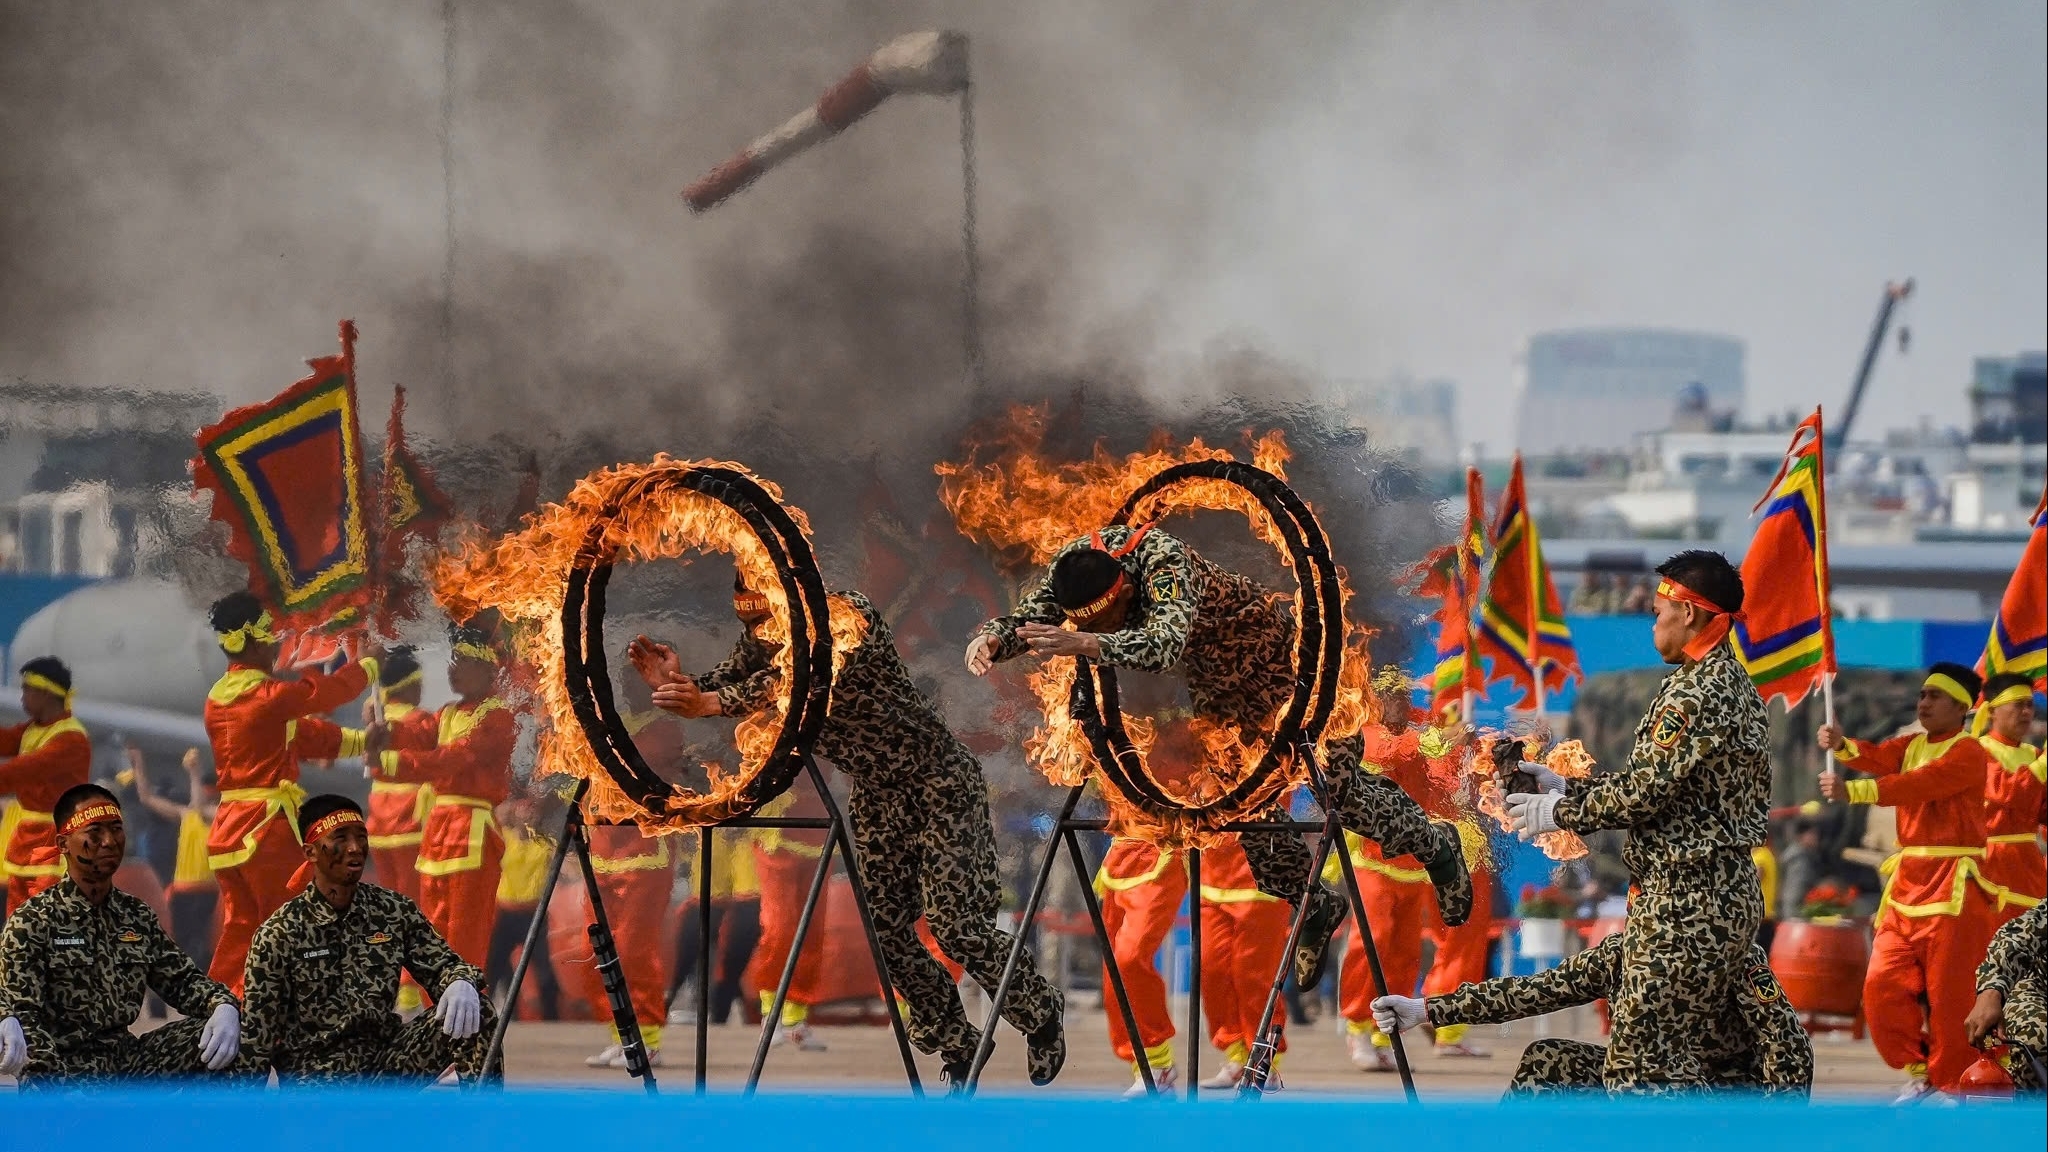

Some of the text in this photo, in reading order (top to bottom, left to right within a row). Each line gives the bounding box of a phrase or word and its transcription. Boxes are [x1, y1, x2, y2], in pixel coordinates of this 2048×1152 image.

[1090, 597, 1109, 614] NAM
[84, 806, 105, 820] CÔNG
[337, 811, 357, 823] CÔNG
